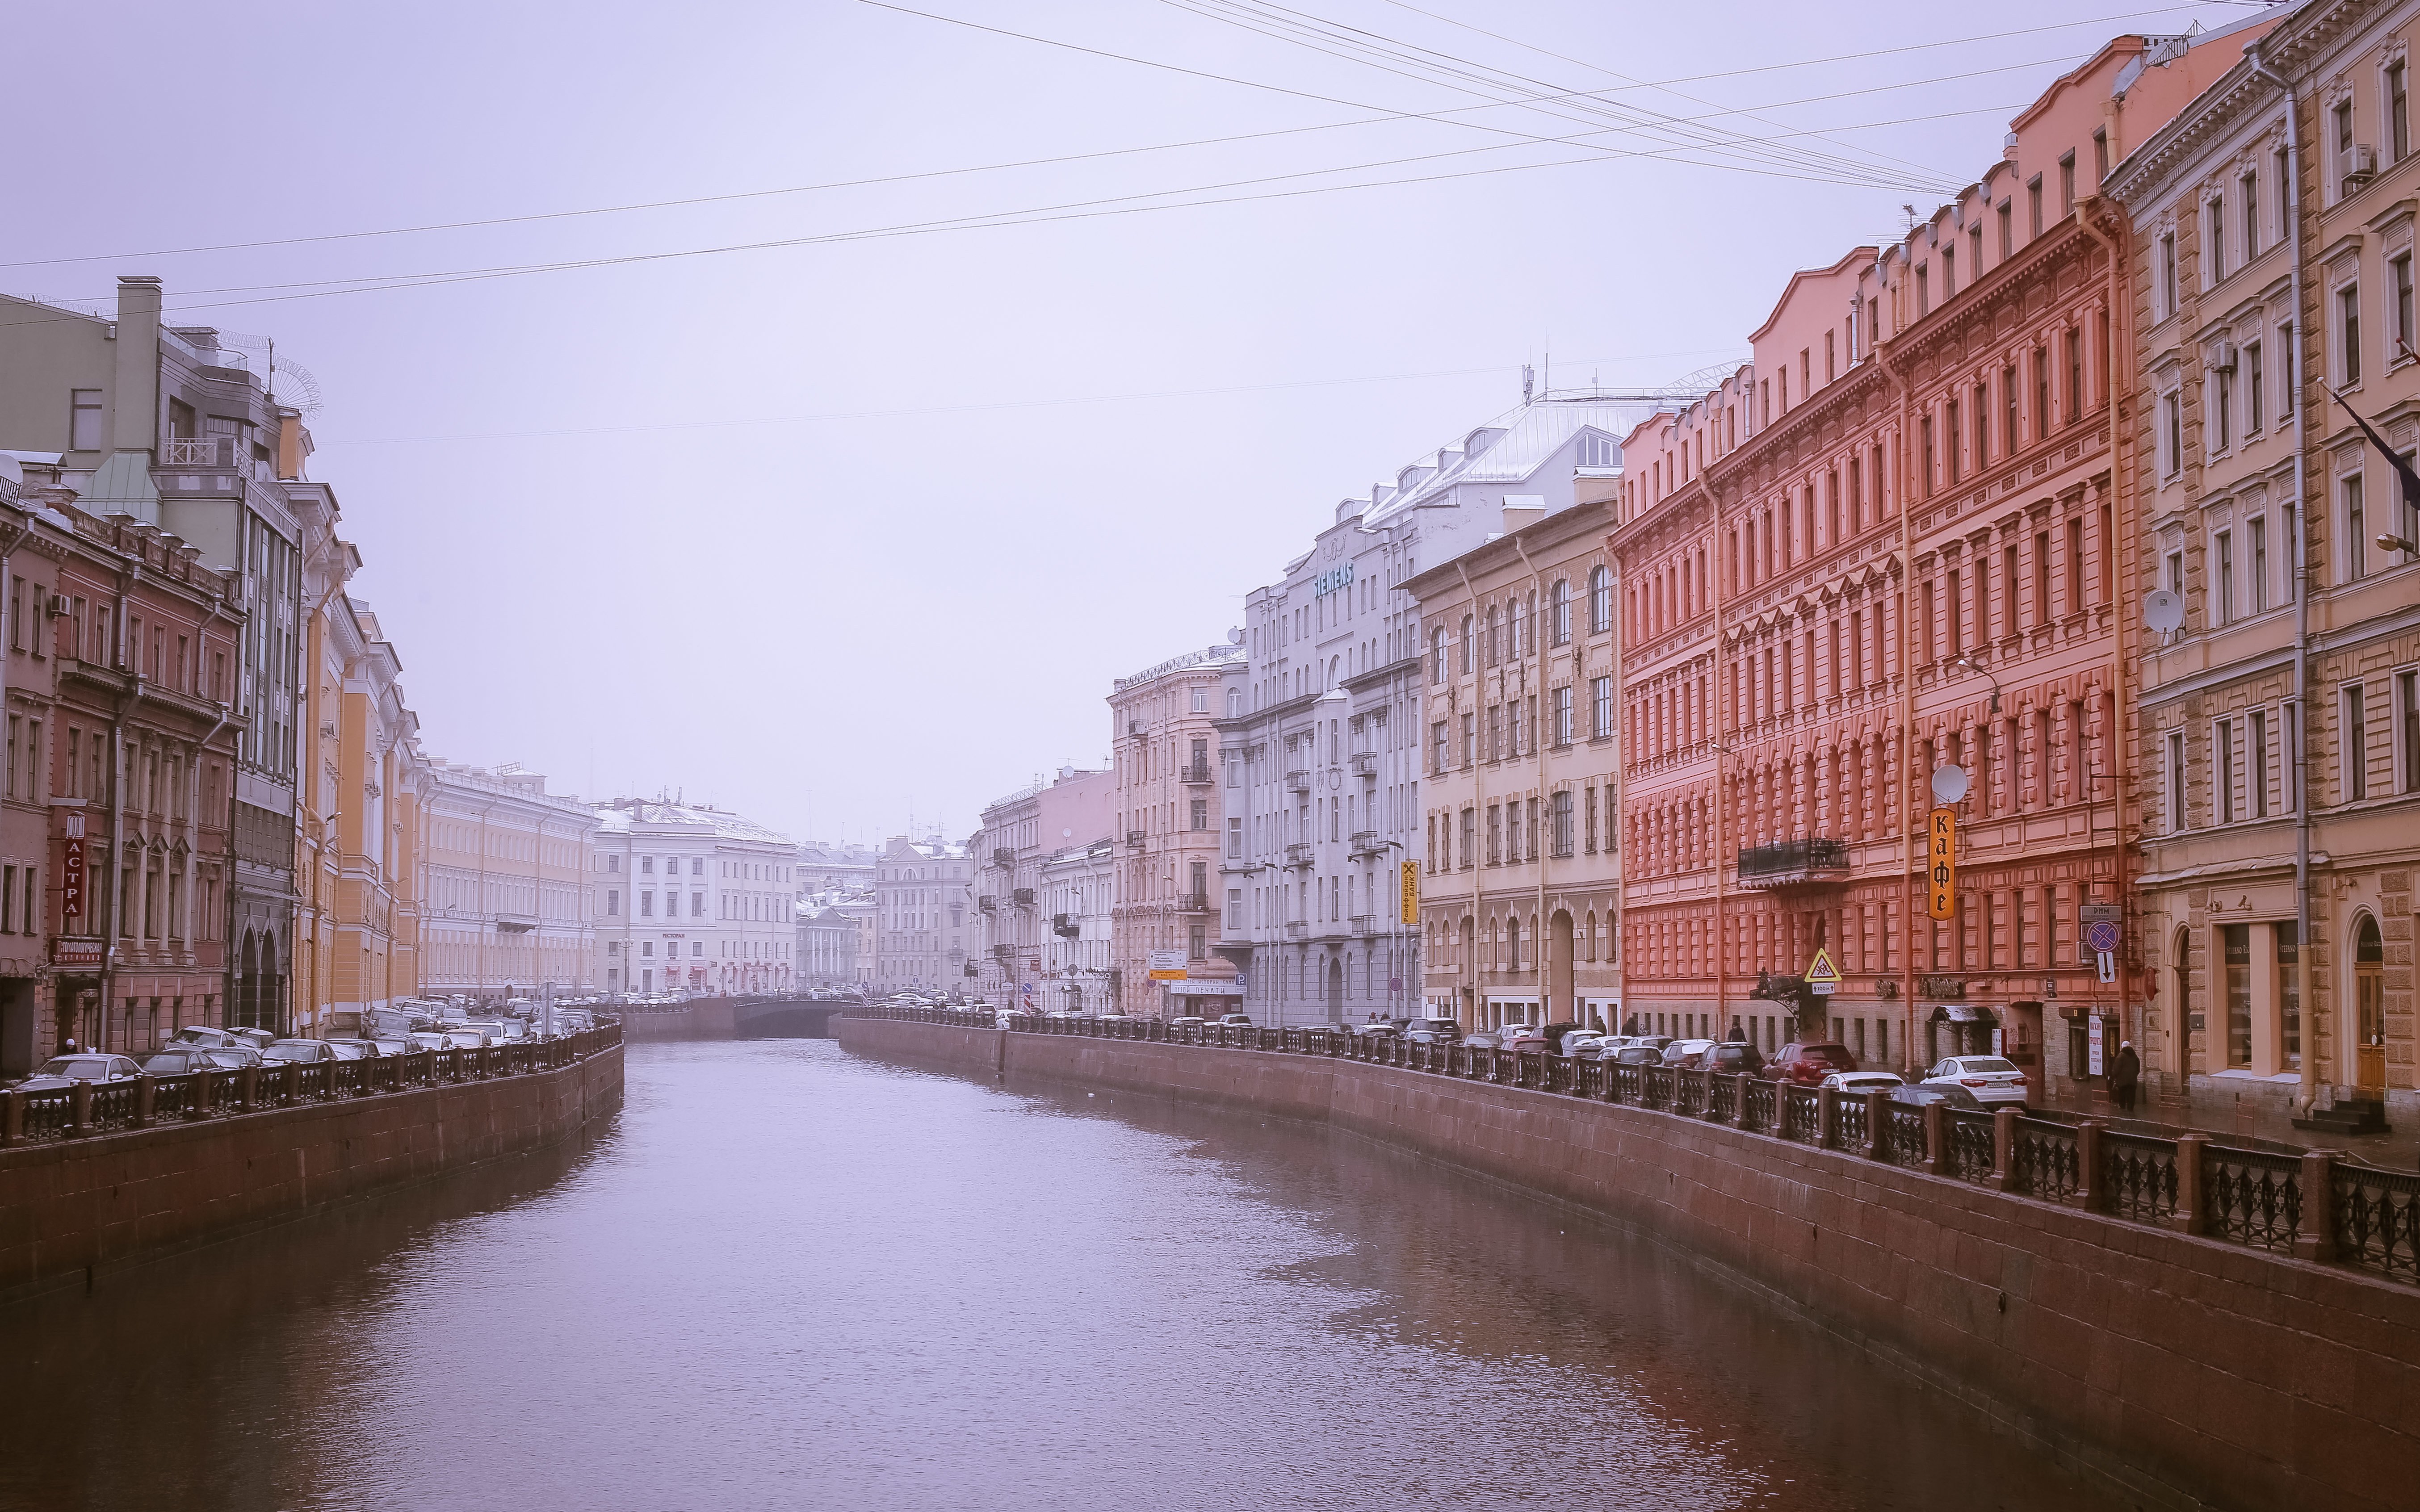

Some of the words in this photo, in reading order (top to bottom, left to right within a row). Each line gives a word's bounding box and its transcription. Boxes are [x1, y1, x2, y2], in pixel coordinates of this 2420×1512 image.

[1315, 562, 1354, 598] SIEMENS
[66, 842, 81, 913] АСТРА
[61, 942, 102, 953] СТОМАТОЛОГИЧЕСКАЯ
[1238, 975, 1245, 984] P
